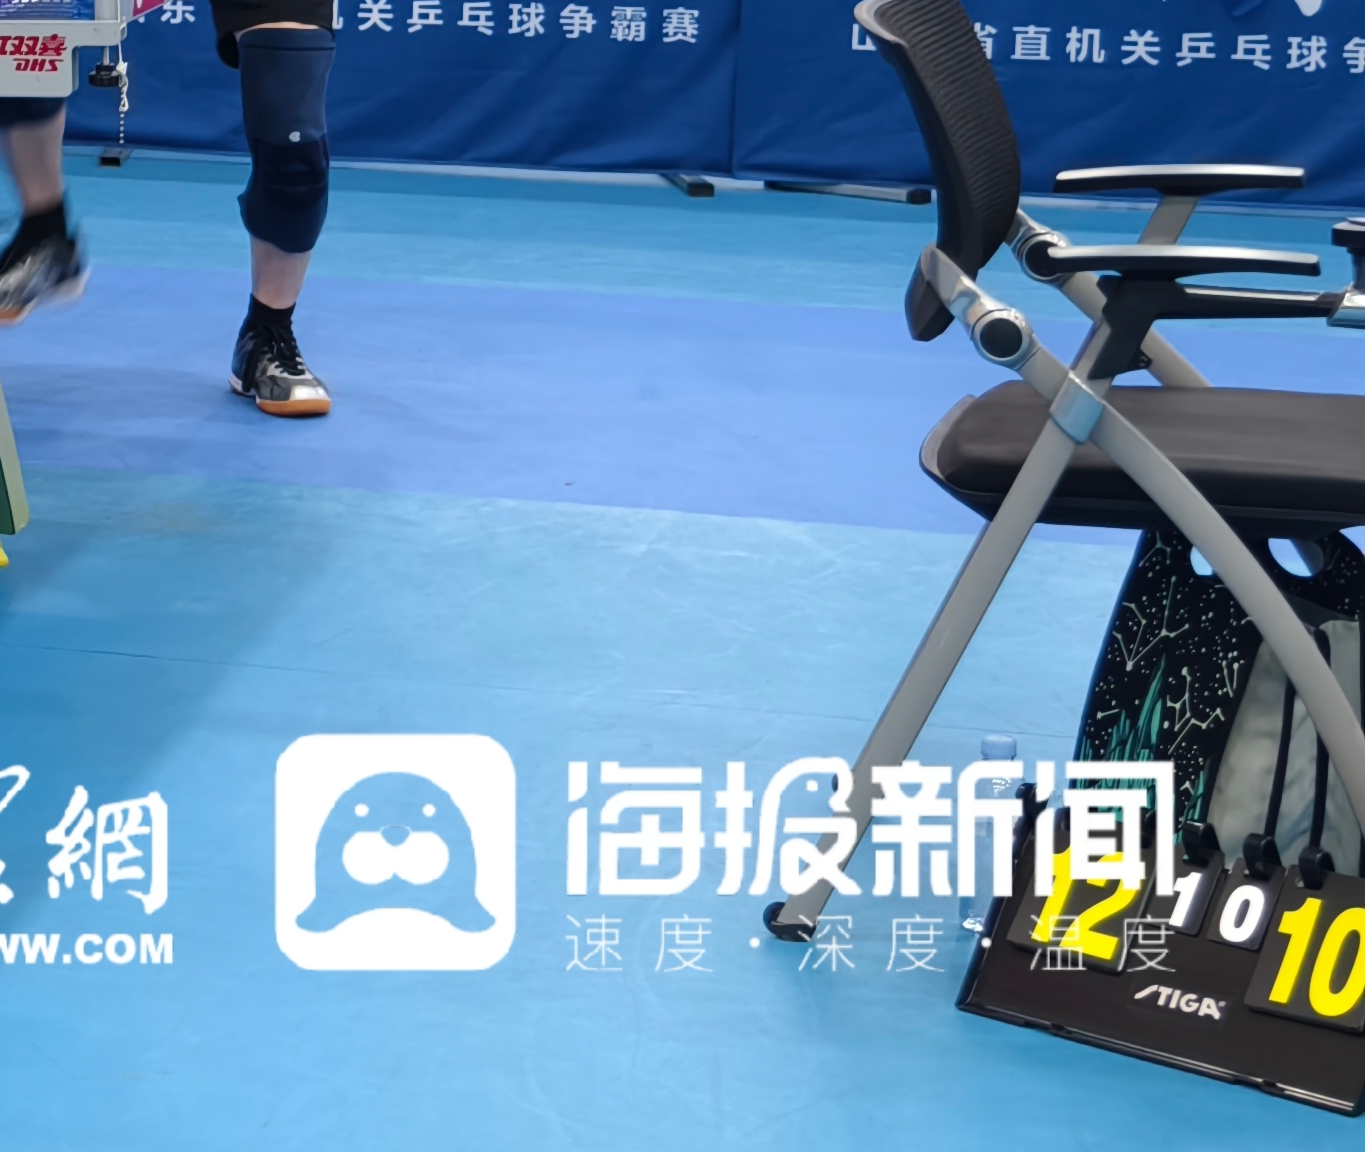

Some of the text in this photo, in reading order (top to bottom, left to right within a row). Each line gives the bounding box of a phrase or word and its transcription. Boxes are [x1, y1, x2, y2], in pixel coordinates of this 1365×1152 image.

[13, 58, 64, 72] DHS
[1169, 872, 1202, 927] 1
[1219, 885, 1265, 943] 0
[1269, 897, 1365, 1017] 10
[1133, 984, 1223, 1020] STIGA
